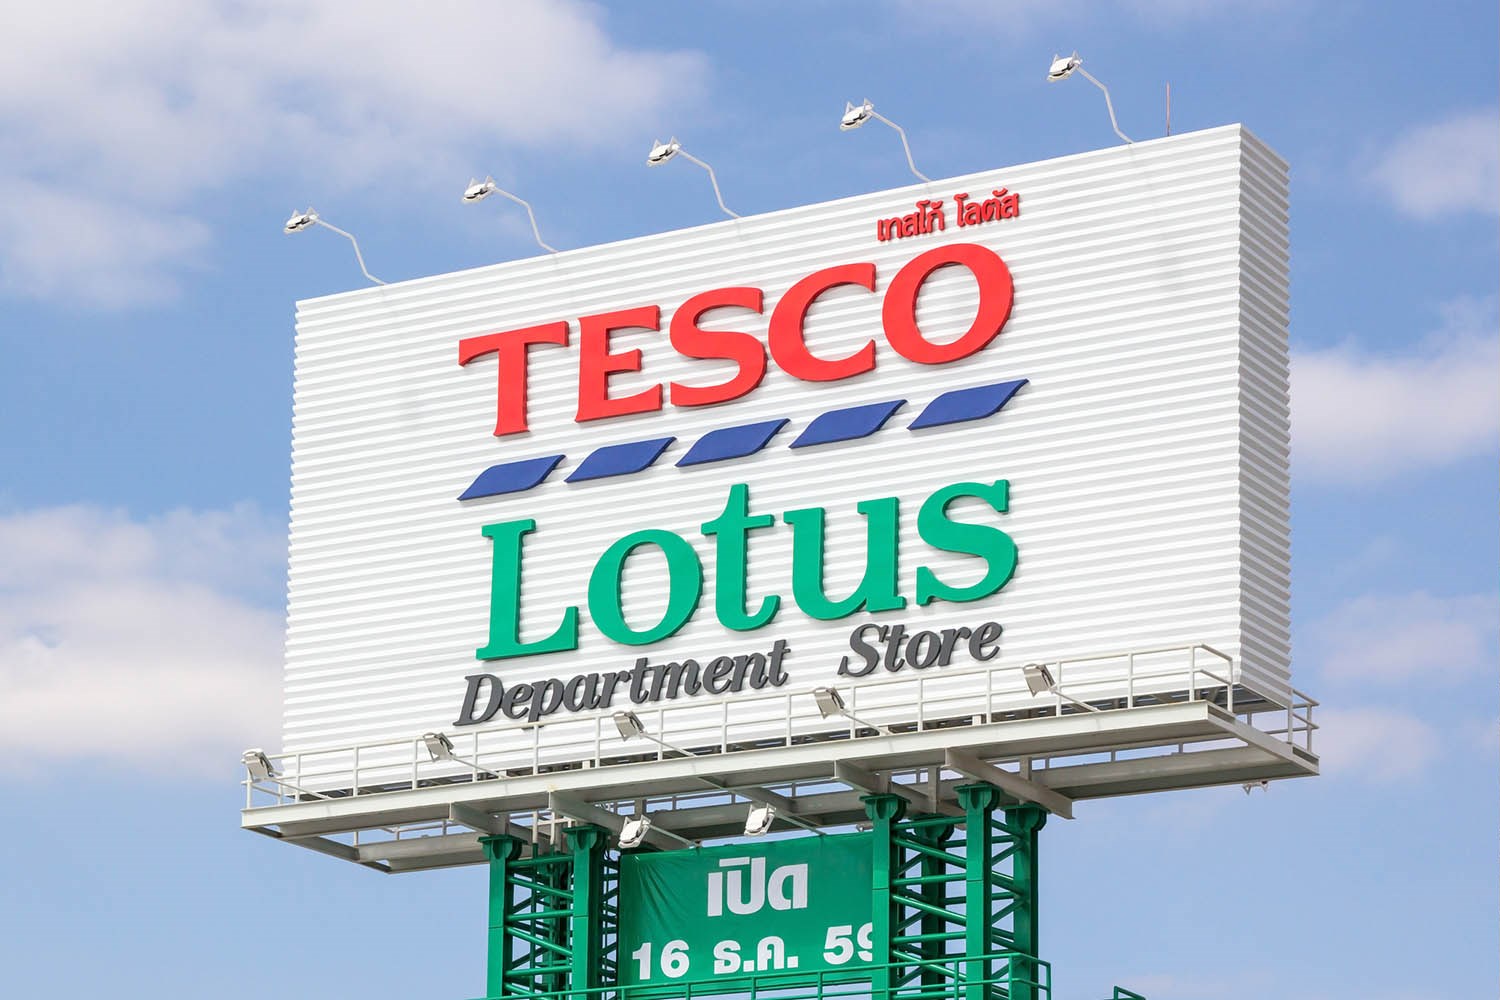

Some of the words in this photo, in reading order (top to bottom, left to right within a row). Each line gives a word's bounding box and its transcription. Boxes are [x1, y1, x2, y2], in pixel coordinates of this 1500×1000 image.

[877, 200, 945, 241] เทสโก้
[953, 187, 1020, 227] โลตัส
[458, 243, 1016, 437] TESCO
[475, 479, 1019, 661] Lotus
[452, 638, 791, 729] Department
[837, 620, 1004, 678] Store
[707, 856, 808, 917] เปิด
[632, 939, 690, 980] 16
[713, 935, 799, 975] ธ.ค.
